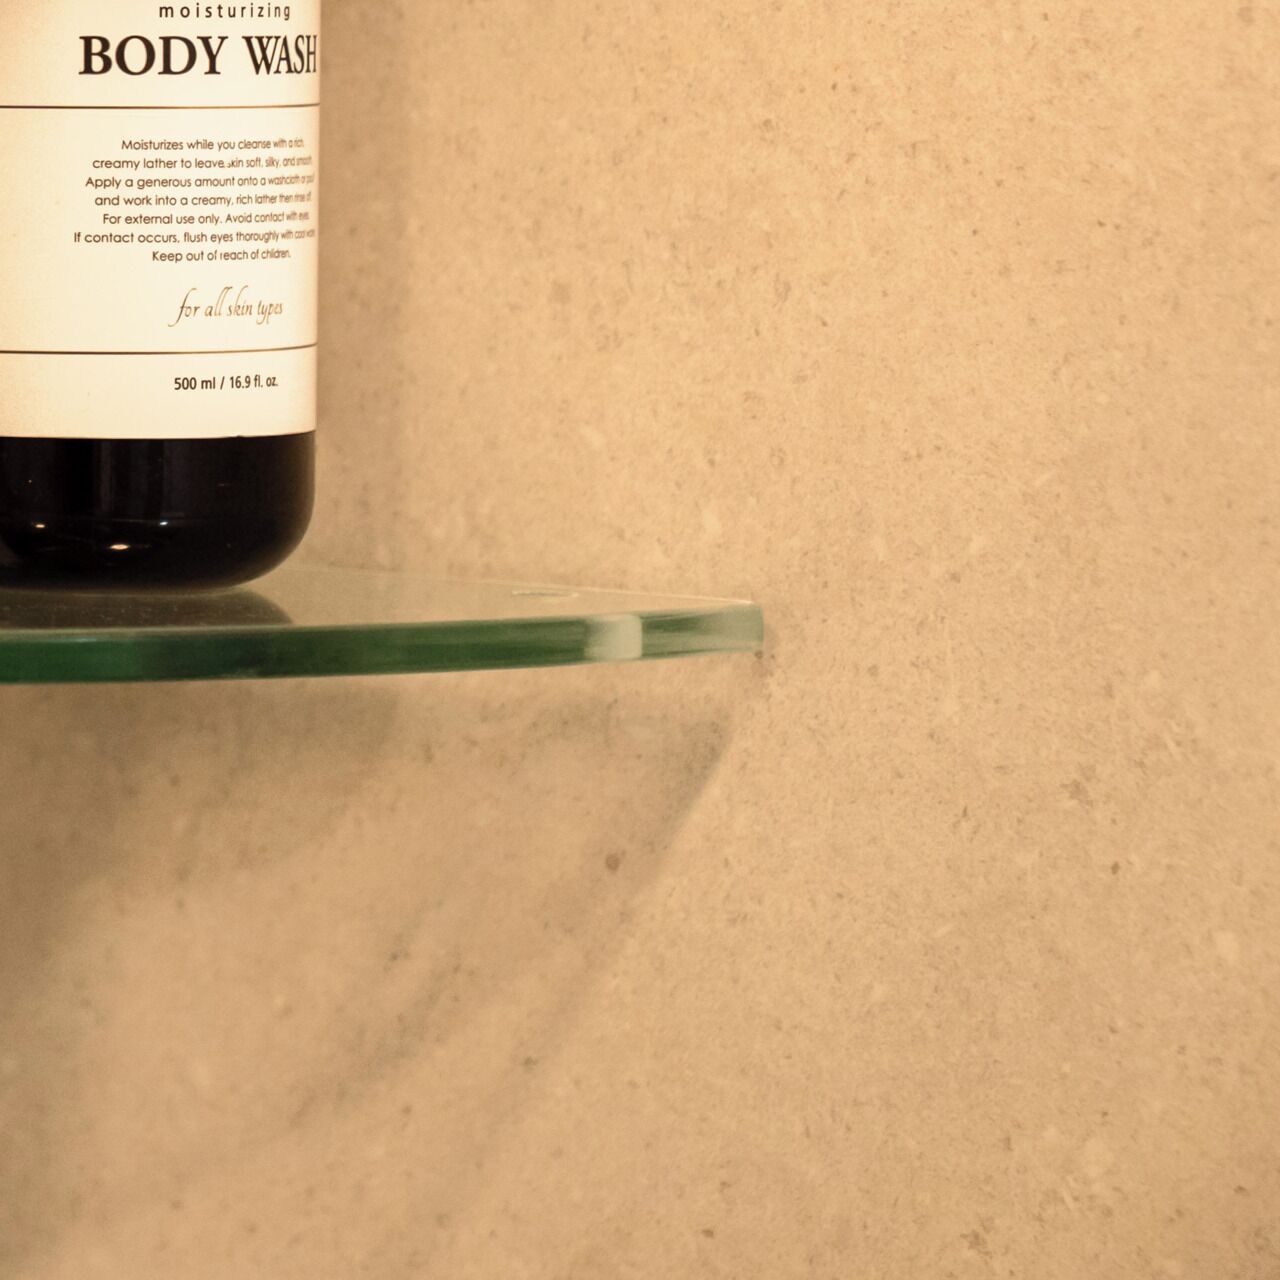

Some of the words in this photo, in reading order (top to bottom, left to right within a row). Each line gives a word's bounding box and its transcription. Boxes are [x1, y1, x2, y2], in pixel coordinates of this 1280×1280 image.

[159, 1, 291, 21] moisturizing
[79, 36, 228, 75] BODY
[242, 35, 318, 74] WASH
[121, 139, 184, 151] Moisturizes
[185, 138, 215, 151] while
[216, 140, 236, 153] you
[237, 139, 272, 151] cleanse
[91, 159, 141, 171] creamy
[143, 157, 179, 169] lather
[194, 157, 226, 169] leave
[85, 176, 122, 190] Apply
[136, 178, 192, 191] generous
[193, 175, 236, 188] amount
[236, 175, 259, 187] onto
[94, 194, 121, 207] and
[122, 195, 153, 207] work
[155, 194, 178, 207] into
[235, 193, 254, 206] rich
[102, 213, 122, 225] For
[124, 213, 173, 225] external
[175, 215, 196, 225] use
[224, 212, 253, 224] Avoid
[83, 232, 135, 244] contact
[183, 231, 208, 244] flush
[209, 233, 234, 245] eyes
[235, 230, 280, 244] thoroughly
[151, 250, 184, 264] Keep
[185, 250, 205, 262] out
[168, 288, 200, 327] for
[204, 288, 232, 317] all
[227, 285, 252, 316] skin
[256, 300, 282, 325] types
[173, 376, 198, 391] 500
[229, 375, 252, 389] 16.9
